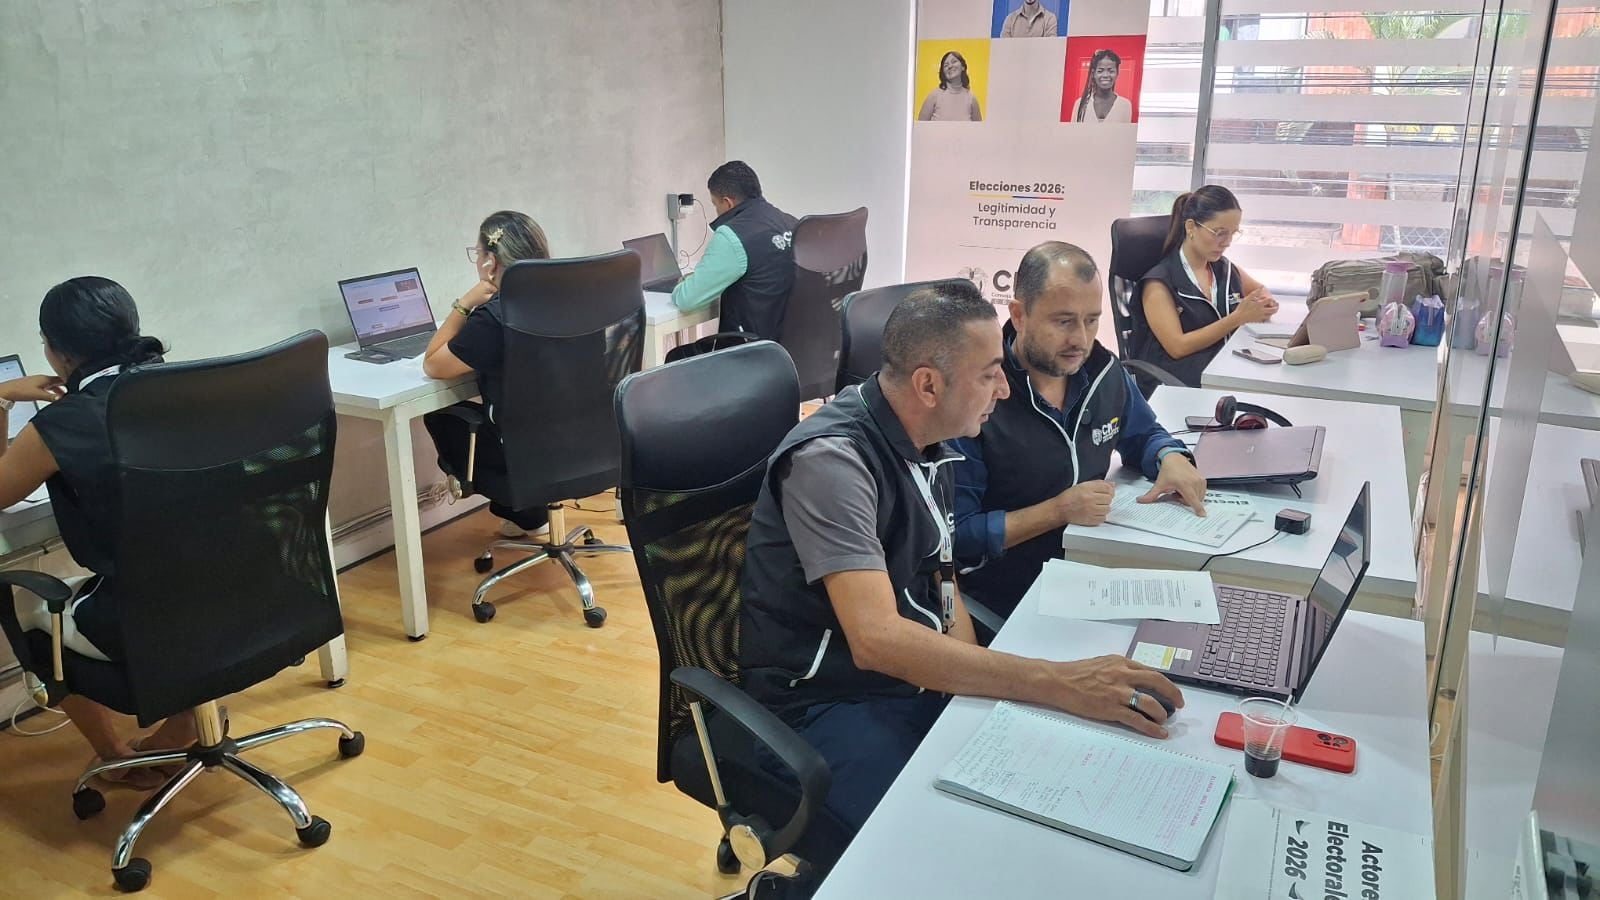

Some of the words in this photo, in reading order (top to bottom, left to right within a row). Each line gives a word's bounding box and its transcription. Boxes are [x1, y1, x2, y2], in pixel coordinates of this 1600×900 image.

[969, 181, 1031, 192] Elecciones
[1033, 183, 1065, 194] 2026:
[973, 216, 1056, 230] Transparencia
[978, 202, 1046, 216] Legitimidad
[1049, 207, 1056, 218] y
[1284, 836, 1309, 881] 2026
[1324, 820, 1350, 900] Electorale
[1361, 840, 1384, 900] Actore
